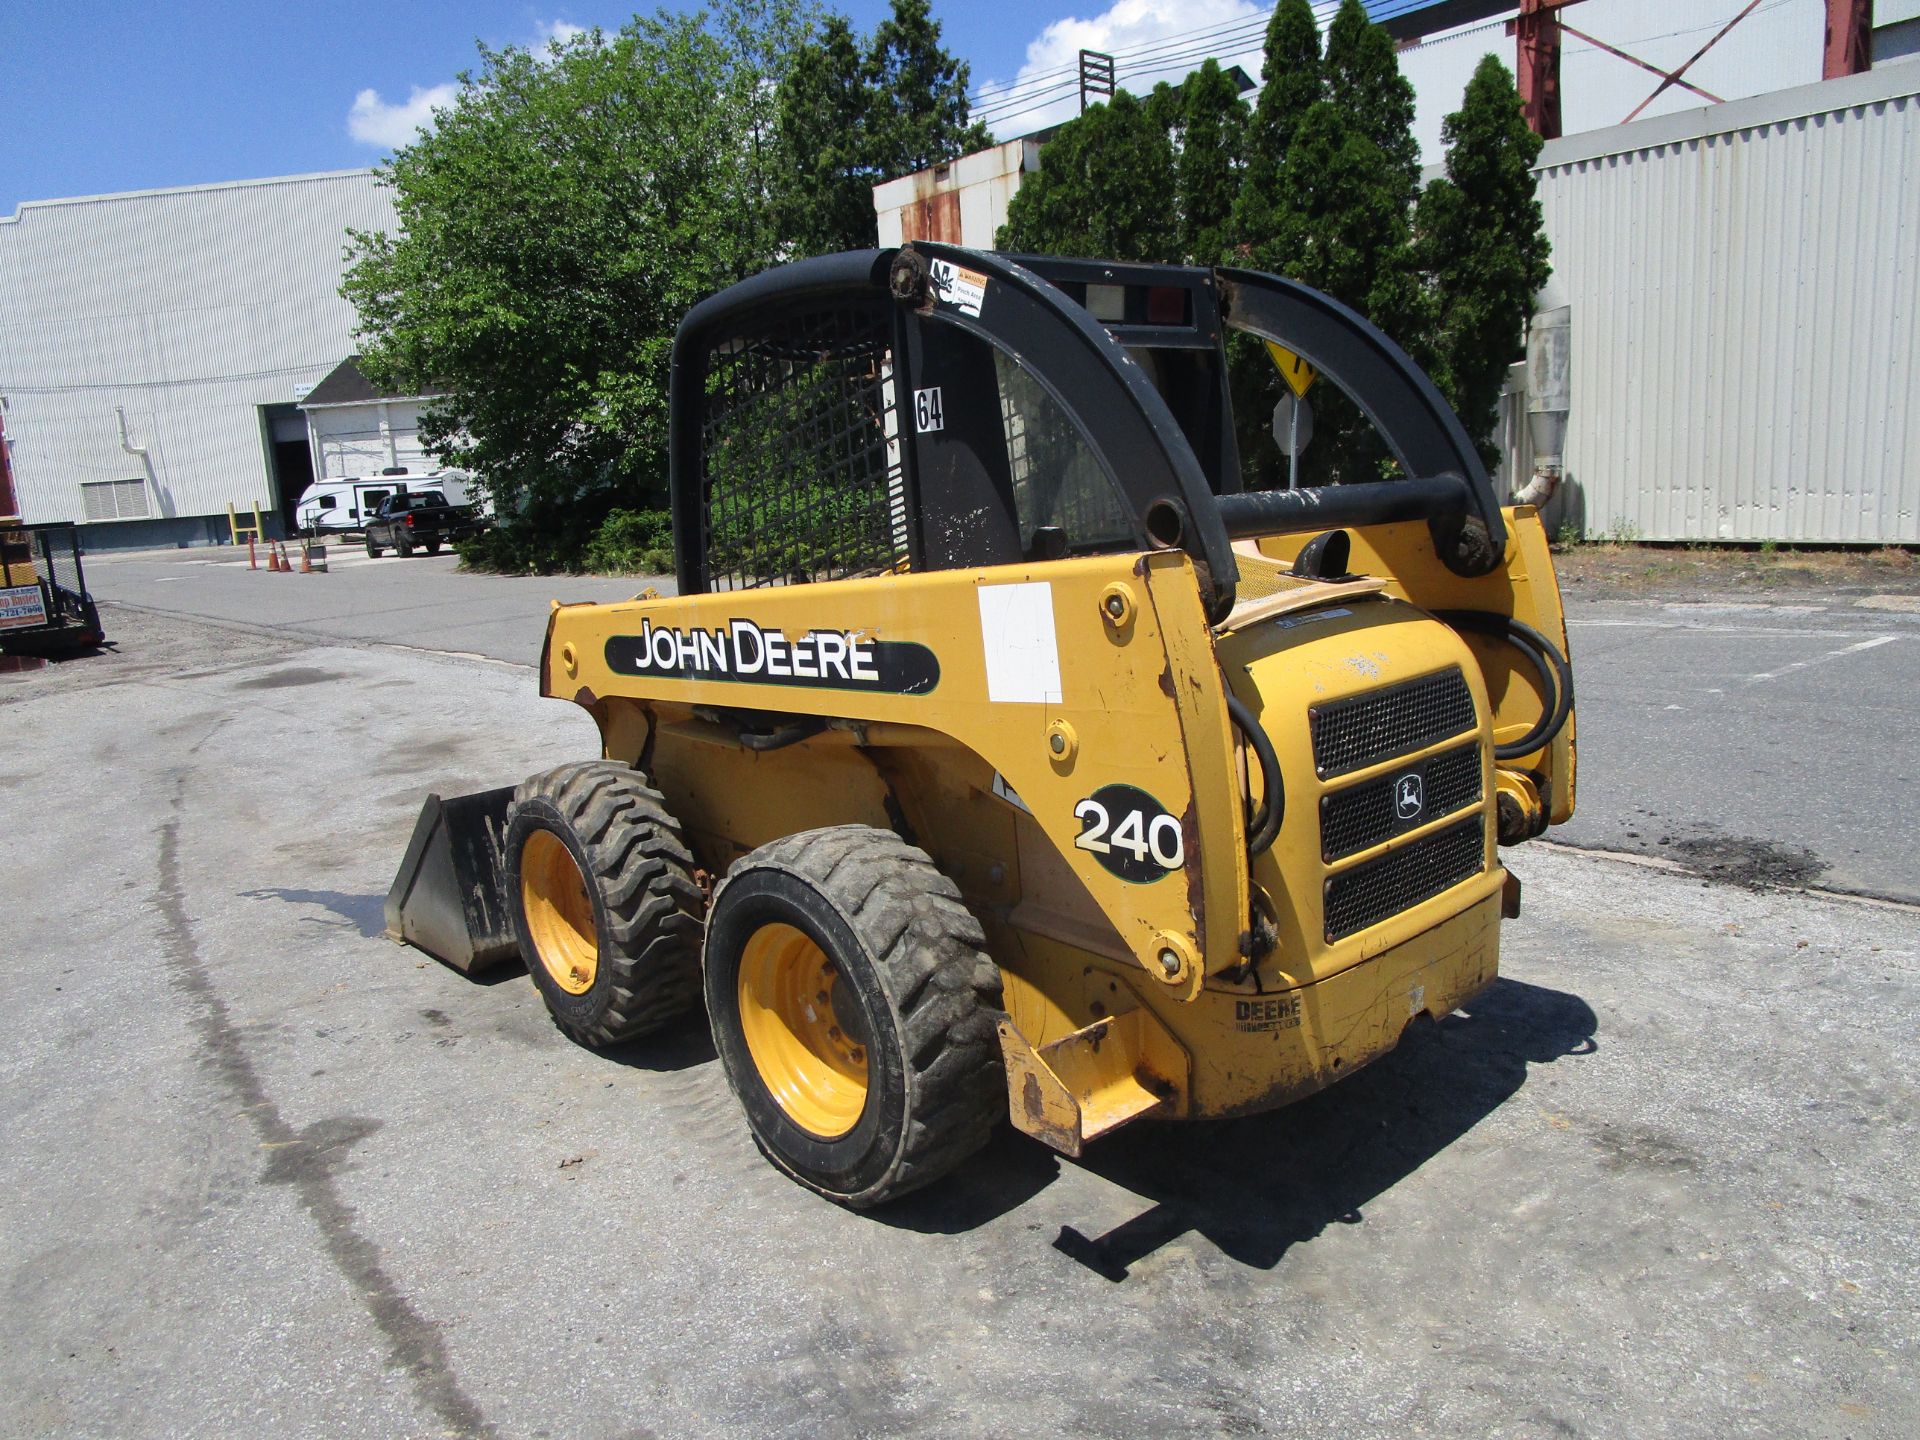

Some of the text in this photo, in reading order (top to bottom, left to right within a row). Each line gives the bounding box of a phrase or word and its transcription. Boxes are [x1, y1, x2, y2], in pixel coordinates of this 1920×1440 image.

[917, 390, 941, 430] 64
[636, 617, 880, 681] JOHN DEERE
[1074, 799, 1186, 870] 240
[1235, 996, 1301, 1020] DEERE
